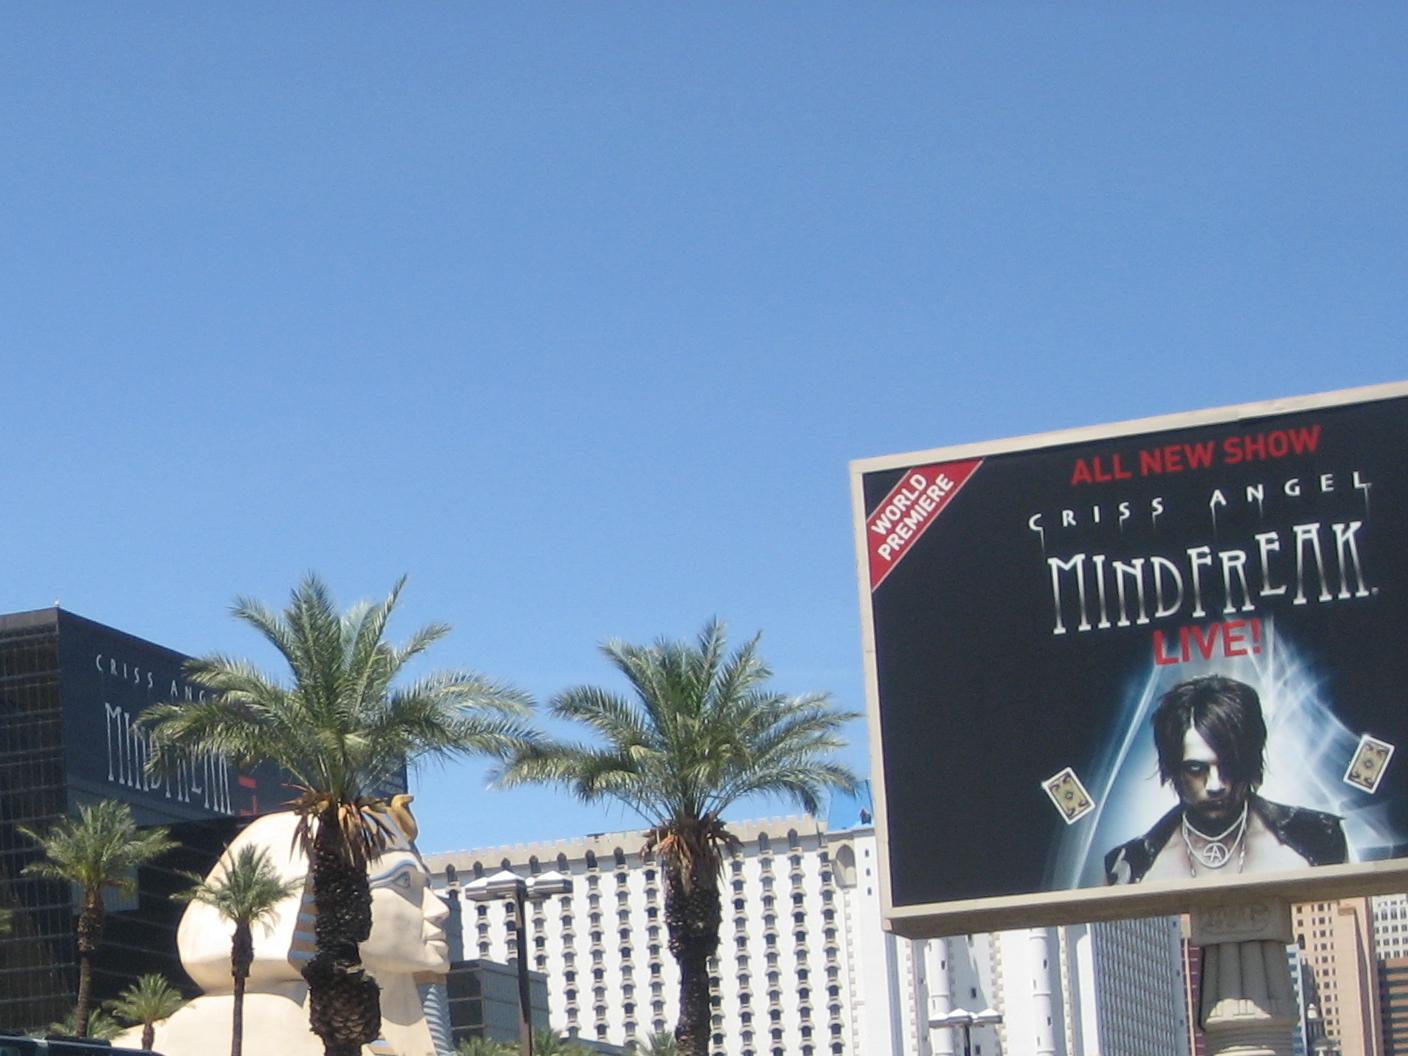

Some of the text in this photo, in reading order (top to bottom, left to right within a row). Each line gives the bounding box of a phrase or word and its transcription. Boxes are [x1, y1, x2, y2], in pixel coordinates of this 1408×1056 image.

[1071, 424, 1322, 485] ALL NEW SHOW
[871, 474, 927, 535] WORLD
[877, 473, 954, 561] PREMIERE
[1028, 471, 1372, 534] CRISS ANGEL
[1047, 521, 1370, 635] MINDFREAK
[1152, 618, 1263, 667] LIVE!
[96, 653, 220, 705] CRISS ANG
